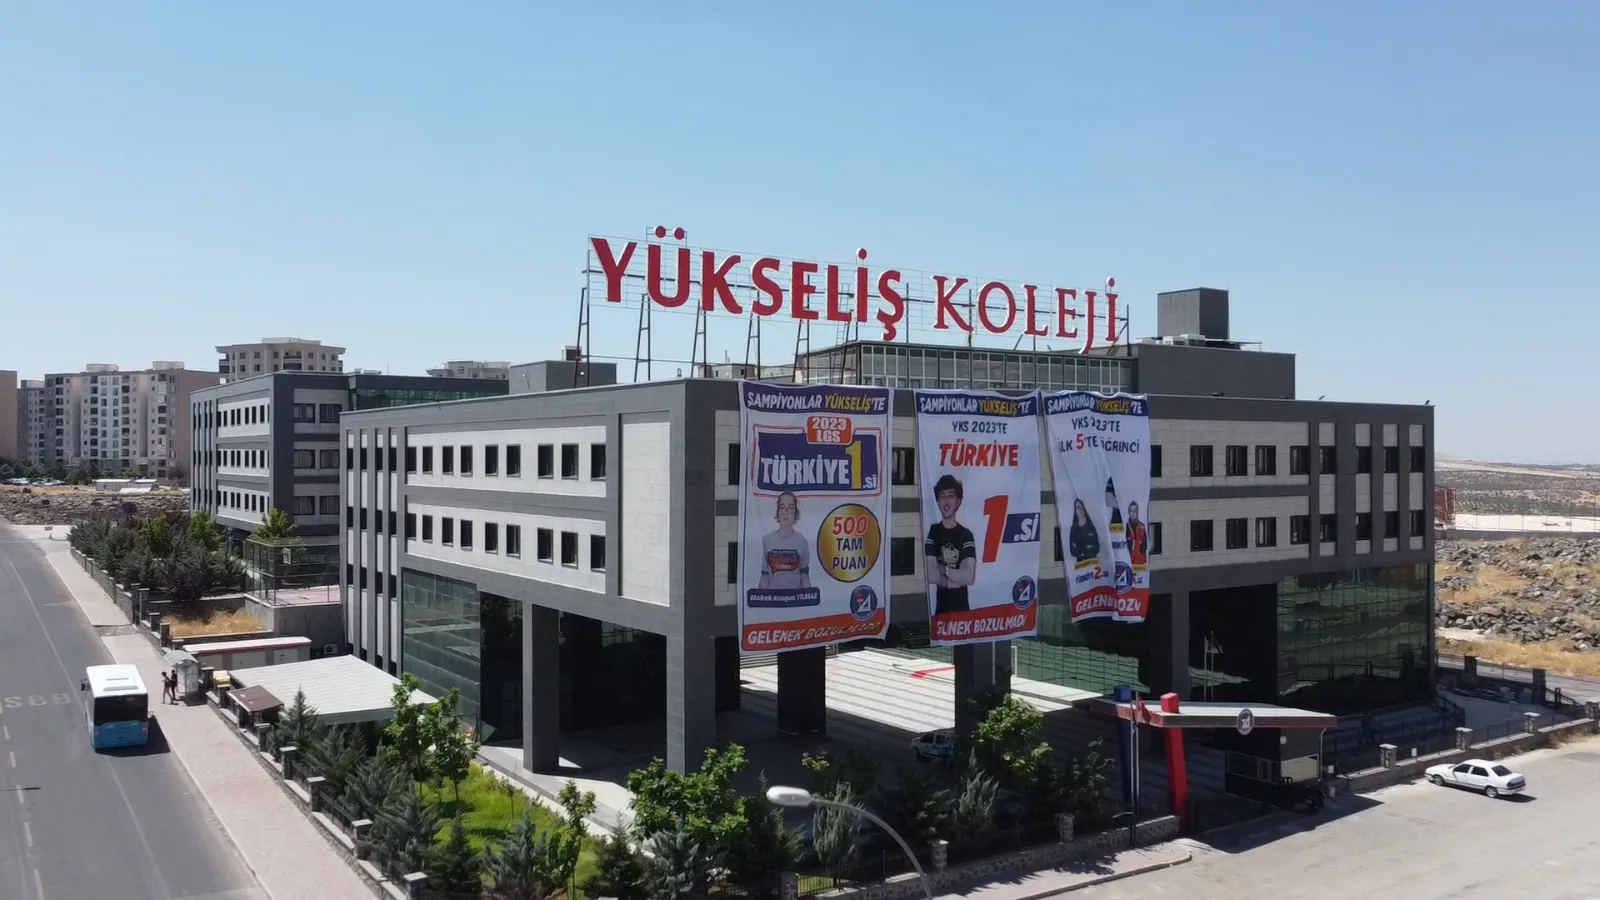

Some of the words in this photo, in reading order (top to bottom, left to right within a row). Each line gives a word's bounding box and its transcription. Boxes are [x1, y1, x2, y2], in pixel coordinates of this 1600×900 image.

[590, 225, 905, 342] YÜKSELİŞ
[931, 277, 1120, 355] KOLEJİ
[748, 391, 822, 410] ŞAMPİYONLAR
[824, 392, 886, 413] YÜKSELİŞ'TE
[920, 396, 978, 414] ŞAMPİYONLAR
[812, 416, 847, 430] 2023
[952, 420, 969, 432] YKS
[971, 420, 1008, 434] 2023'TE
[1072, 416, 1089, 430] YKS
[816, 429, 841, 443] LGS
[1076, 433, 1098, 450] 5'TE
[939, 438, 1019, 467] TÜRKİYE
[761, 454, 850, 485] TÜRKİYE
[832, 515, 868, 535] 500
[836, 538, 863, 551] TAM
[832, 555, 867, 570] PUAN
[747, 629, 806, 645] GELENEK
